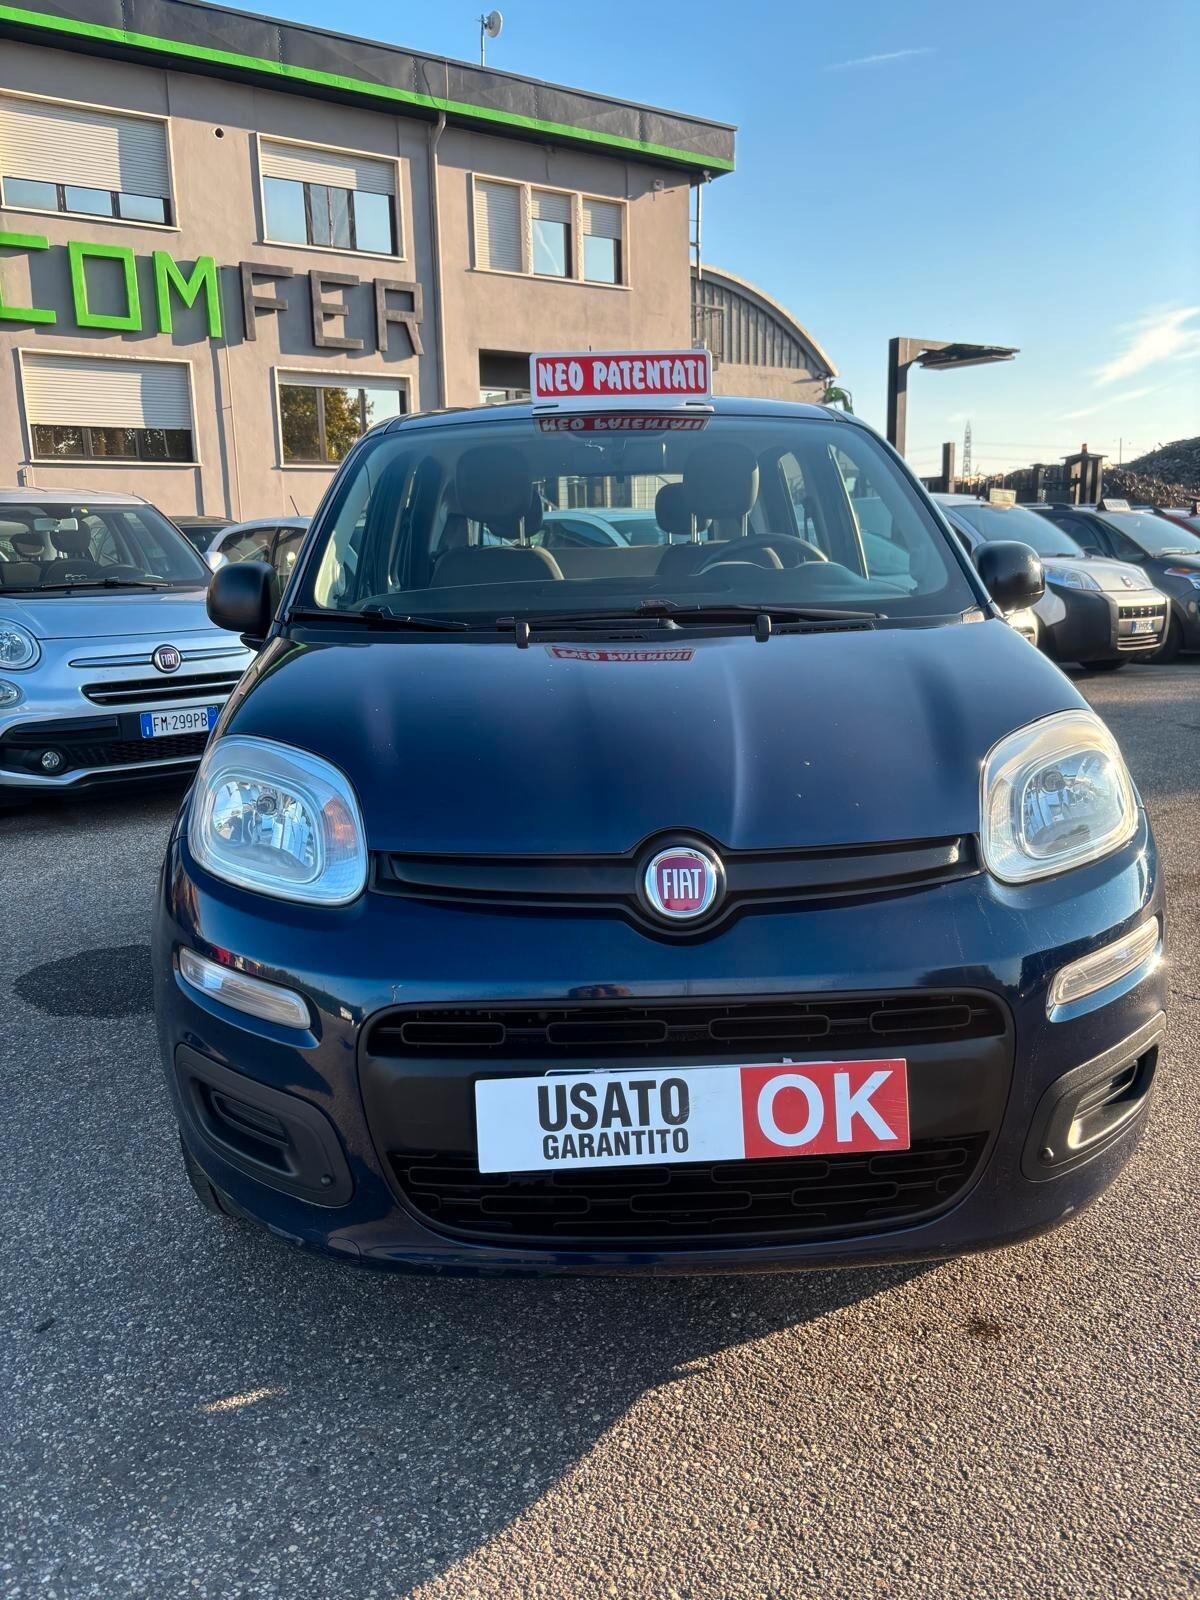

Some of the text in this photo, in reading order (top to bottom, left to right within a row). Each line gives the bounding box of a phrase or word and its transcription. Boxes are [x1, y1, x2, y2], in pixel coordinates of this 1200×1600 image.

[538, 359, 705, 392] NEO PATENTATI
[161, 653, 176, 666] FIAT
[662, 868, 702, 900] FIAT
[537, 1077, 690, 1132] USATO
[757, 1070, 899, 1147] OK
[542, 1127, 689, 1160] GARANTITO
